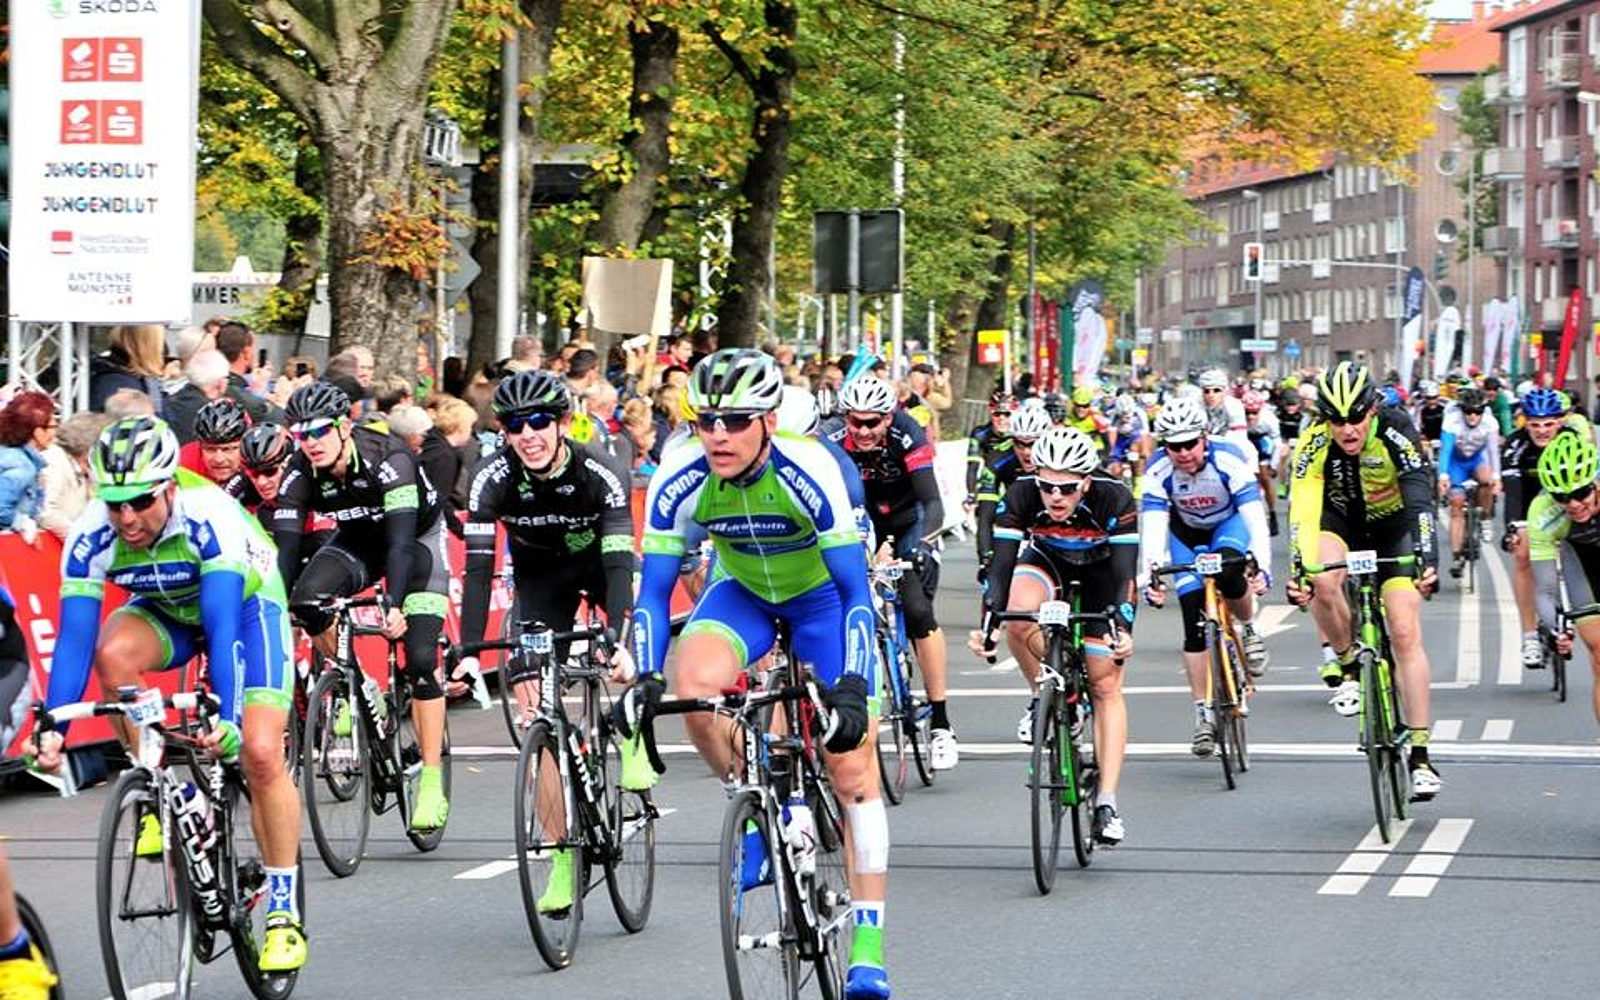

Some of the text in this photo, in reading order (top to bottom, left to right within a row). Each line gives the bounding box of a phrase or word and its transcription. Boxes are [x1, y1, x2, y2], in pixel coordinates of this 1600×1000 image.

[68, 272, 133, 282] ANTENNE
[657, 469, 705, 518] ALPINA
[780, 466, 822, 519] ALPINA
